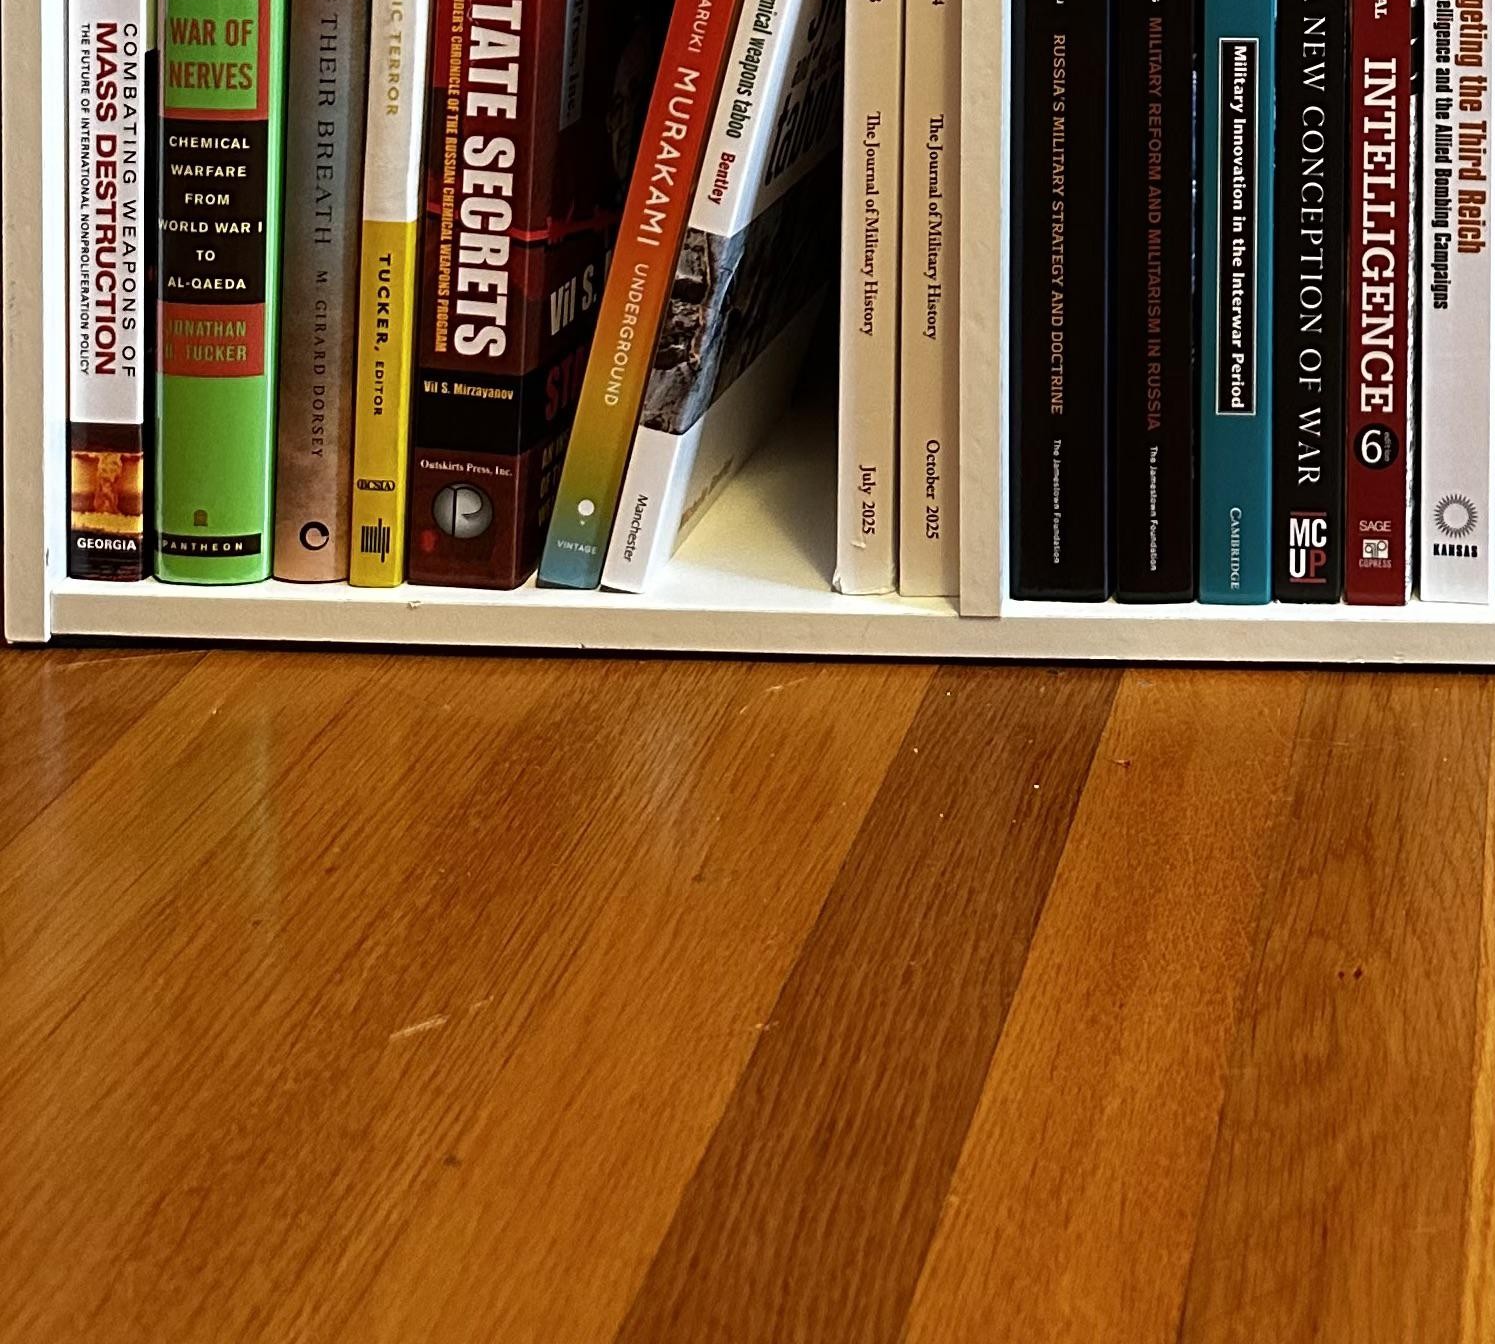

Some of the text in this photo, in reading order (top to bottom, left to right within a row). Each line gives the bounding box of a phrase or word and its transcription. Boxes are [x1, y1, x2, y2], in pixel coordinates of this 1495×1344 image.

[169, 136, 250, 148] CHEMICAL
[386, 32, 403, 116] TERROR
[95, 22, 117, 376] MASS DESTRUCTION
[122, 24, 139, 378] COMBATING WEAPONS OF
[171, 165, 247, 177] WARFARE
[636, 67, 700, 248] MURAKAMI
[1227, 46, 1248, 408] Military Innovation in the Interwar Period
[372, 253, 393, 352] TUCKER,
[453, 136, 512, 358] SECRETS
[1360, 58, 1395, 412] INTELLIGENCE
[602, 263, 649, 406] UNDERGROUND
[77, 538, 138, 549] GEORGIA
[925, 440, 941, 539] October 2025
